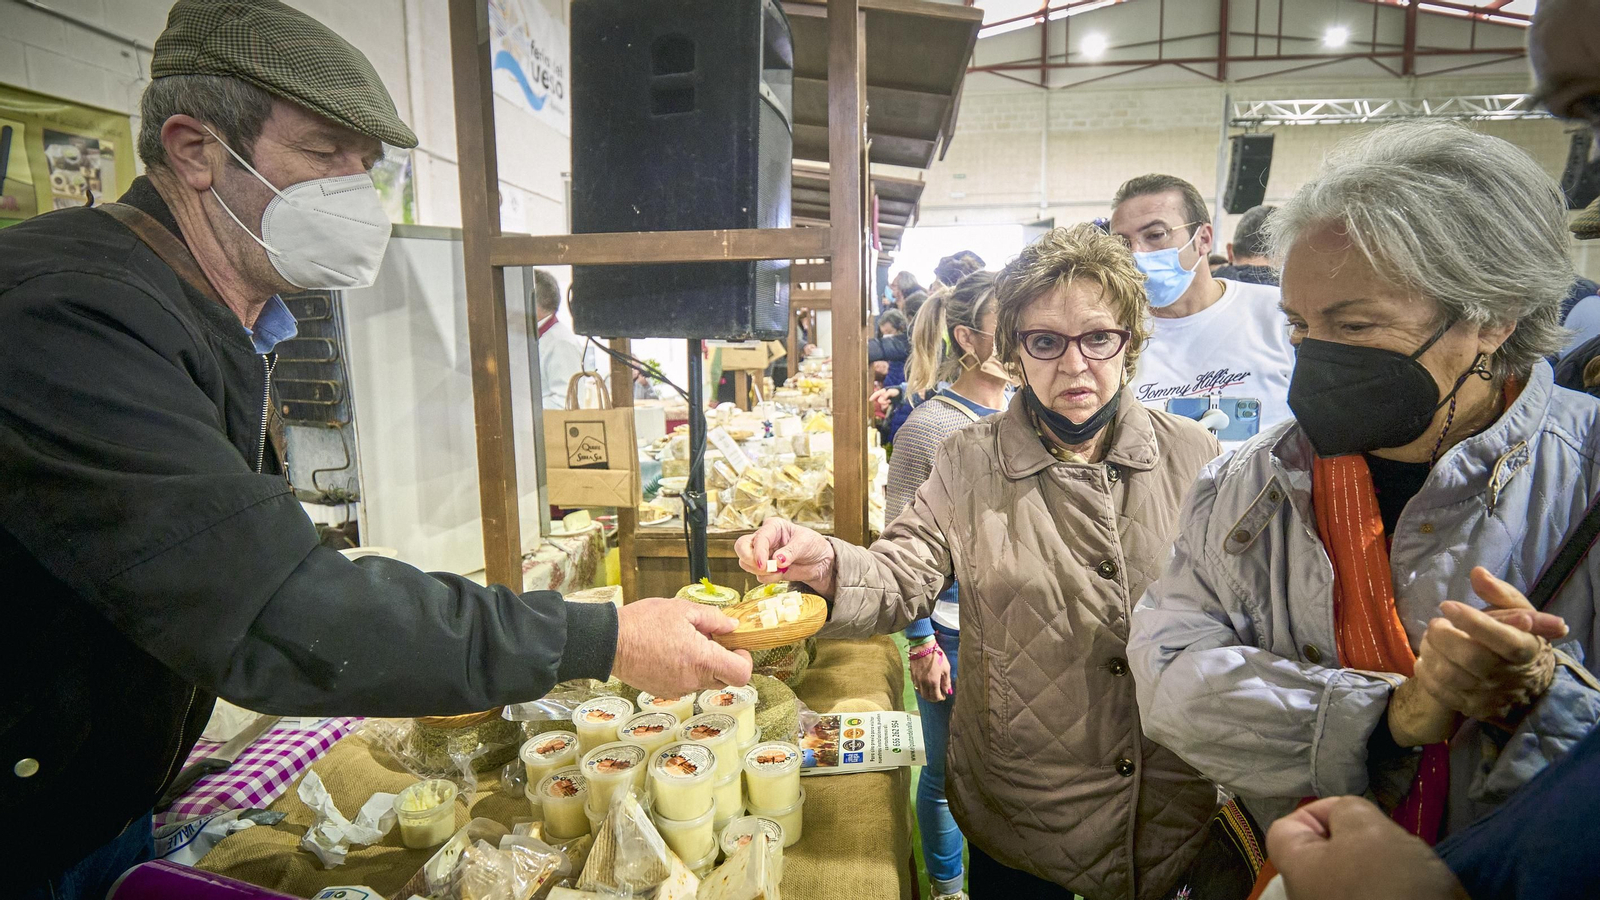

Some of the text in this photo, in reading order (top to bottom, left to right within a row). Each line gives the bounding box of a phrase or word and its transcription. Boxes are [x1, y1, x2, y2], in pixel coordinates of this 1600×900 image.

[1136, 368, 1251, 400] Tommy Hilfiger
[891, 720, 899, 728] 954
[892, 729, 900, 737] 262
[167, 824, 194, 850] VALLE
